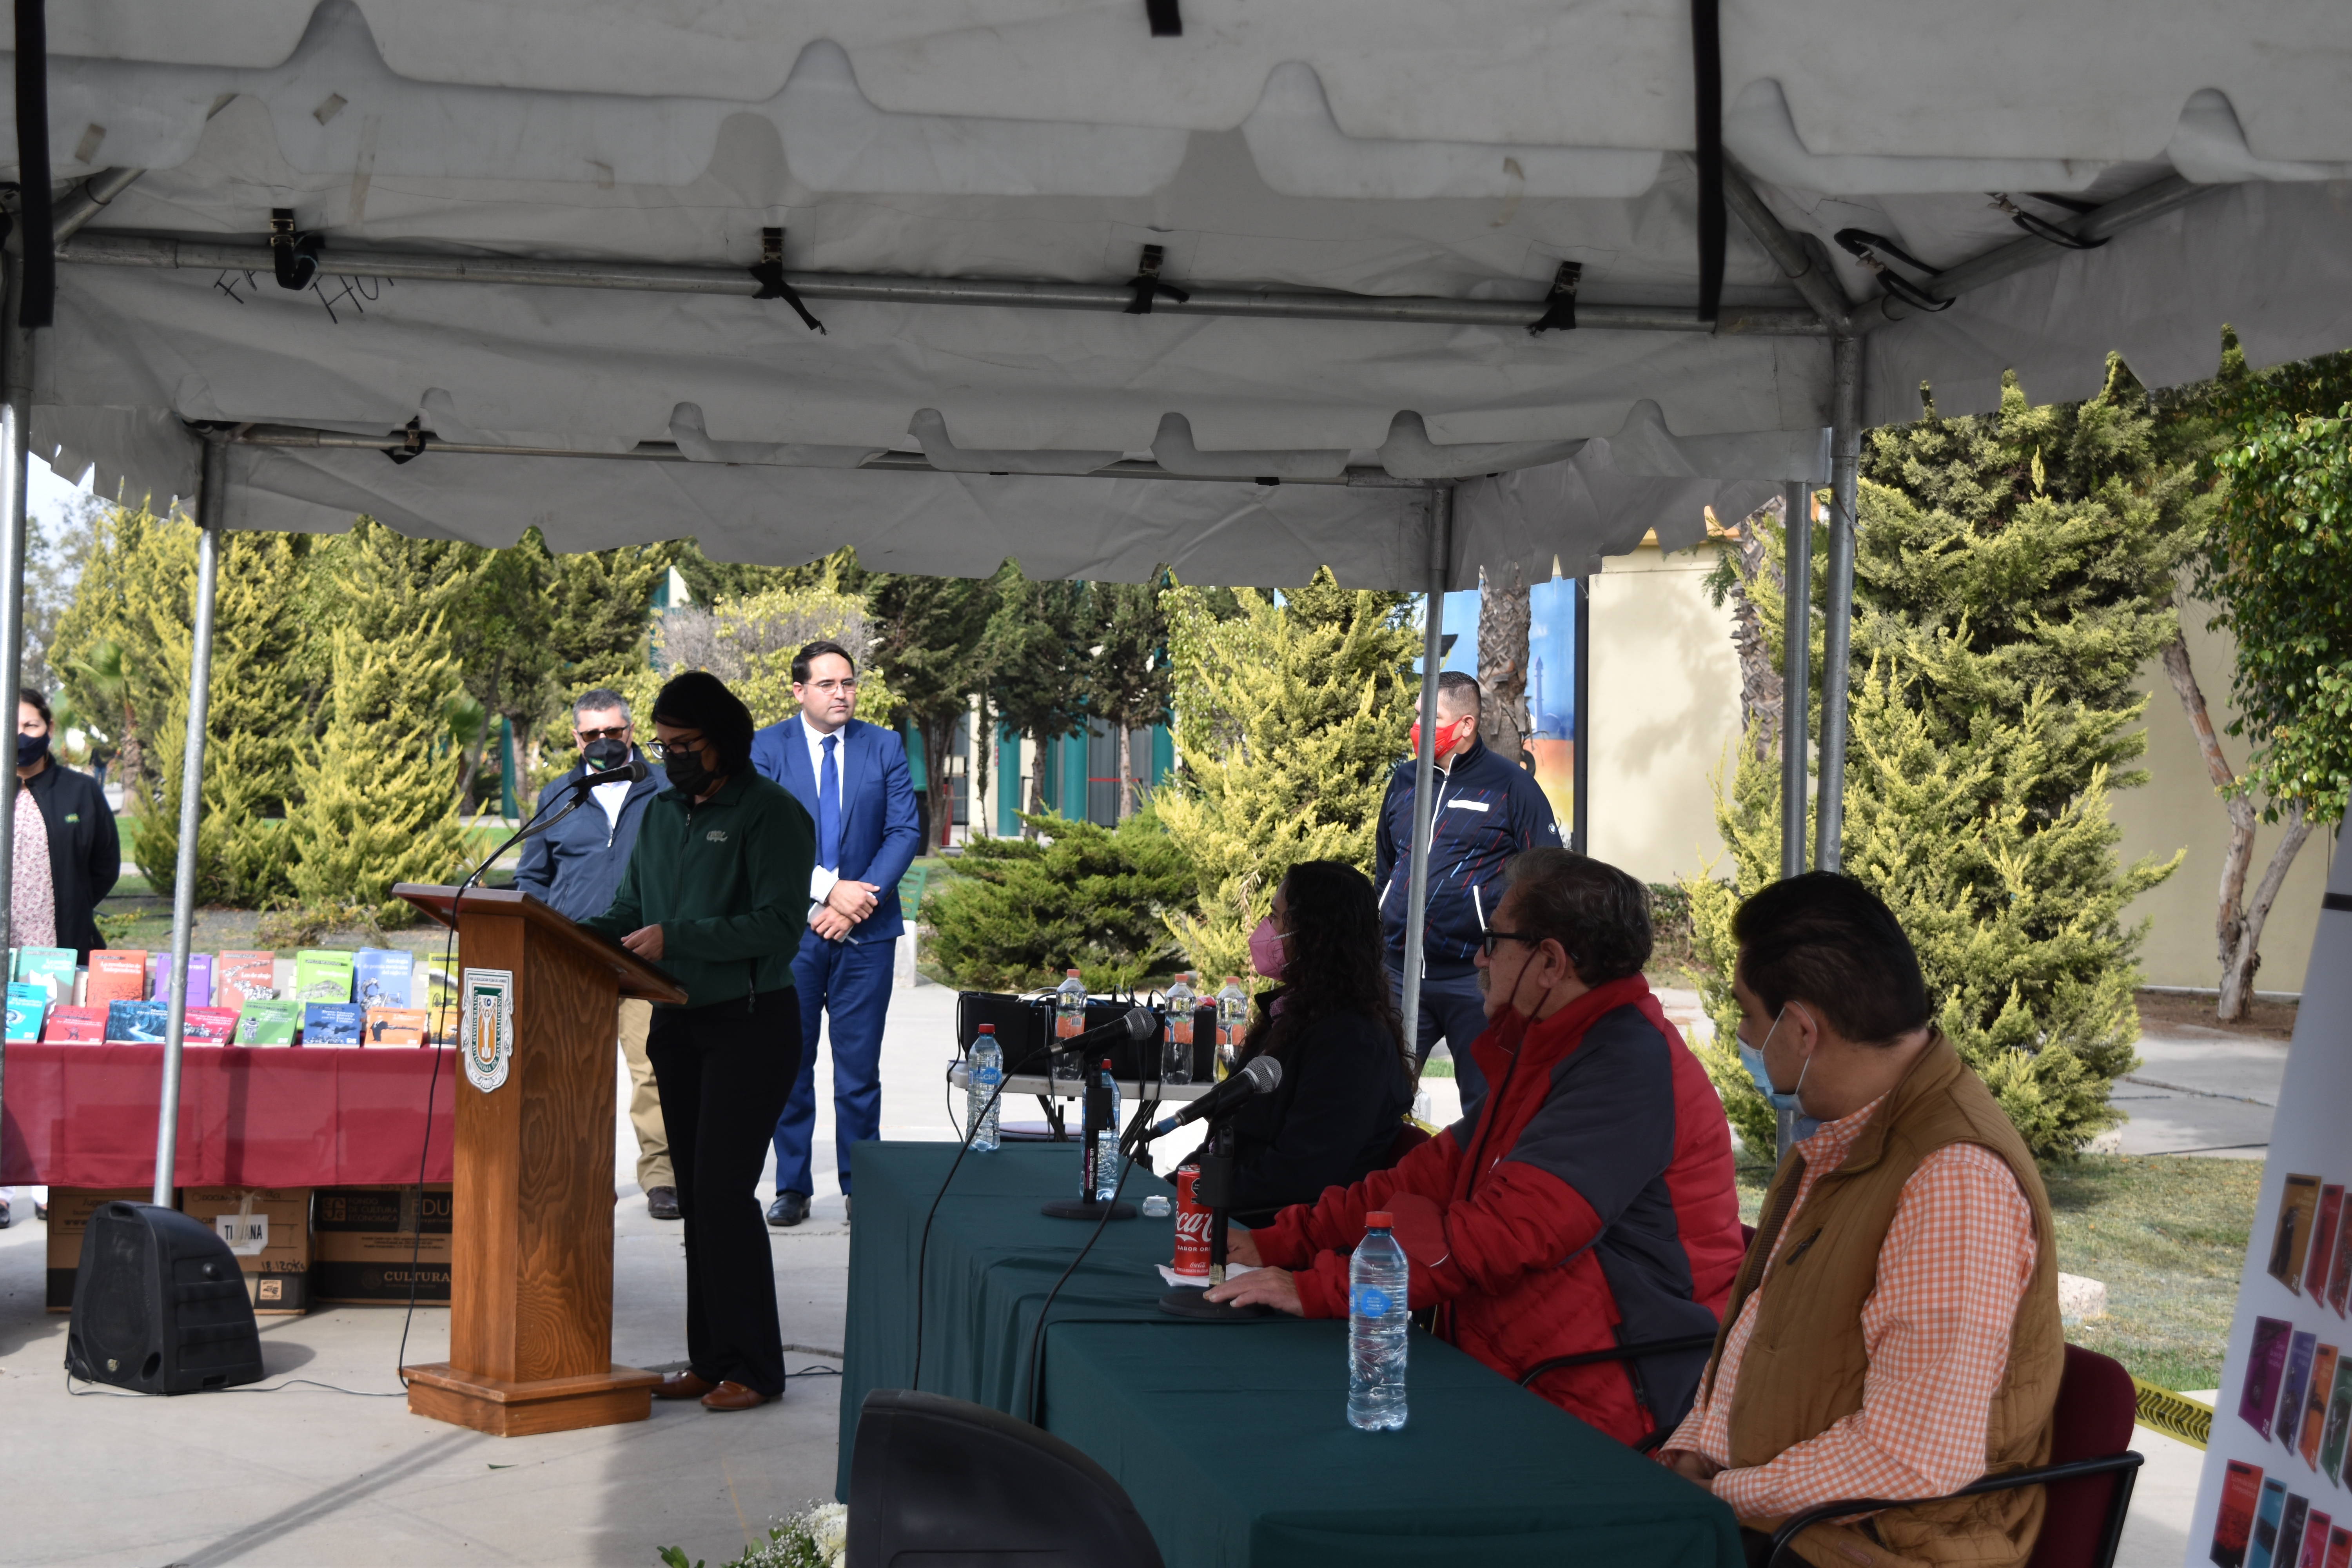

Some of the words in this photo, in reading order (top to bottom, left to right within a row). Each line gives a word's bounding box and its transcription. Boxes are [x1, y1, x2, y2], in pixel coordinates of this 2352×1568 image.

[984, 1071, 997, 1080] ciel
[412, 1199, 453, 1216] EDU
[224, 1224, 262, 1240] TIANA
[384, 1271, 450, 1281] CULTURA
